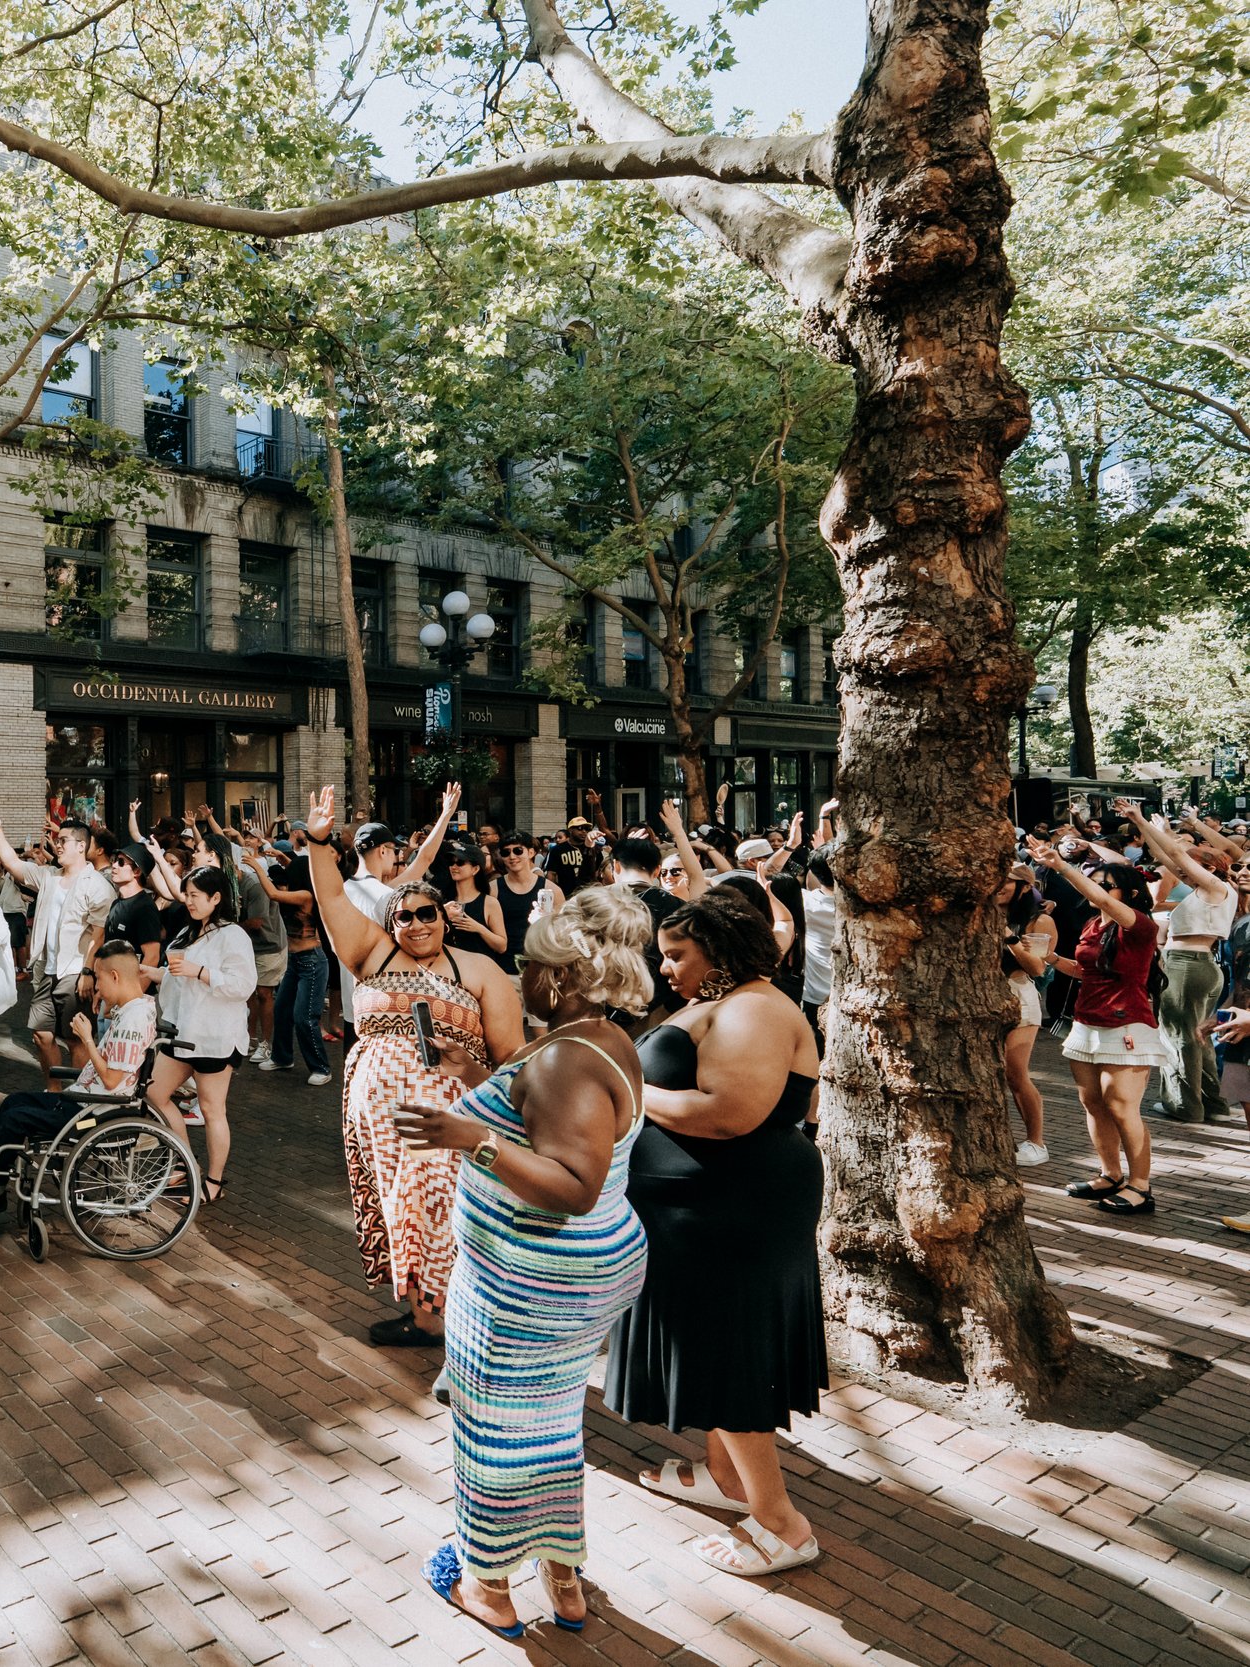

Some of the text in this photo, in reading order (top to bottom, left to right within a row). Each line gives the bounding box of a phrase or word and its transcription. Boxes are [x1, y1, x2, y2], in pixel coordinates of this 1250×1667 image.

[73, 681, 277, 709] OCCIDENTAL GALLERY
[394, 706, 493, 722] wine nosh
[425, 688, 434, 745] SQUA
[623, 717, 666, 735] Valcucine
